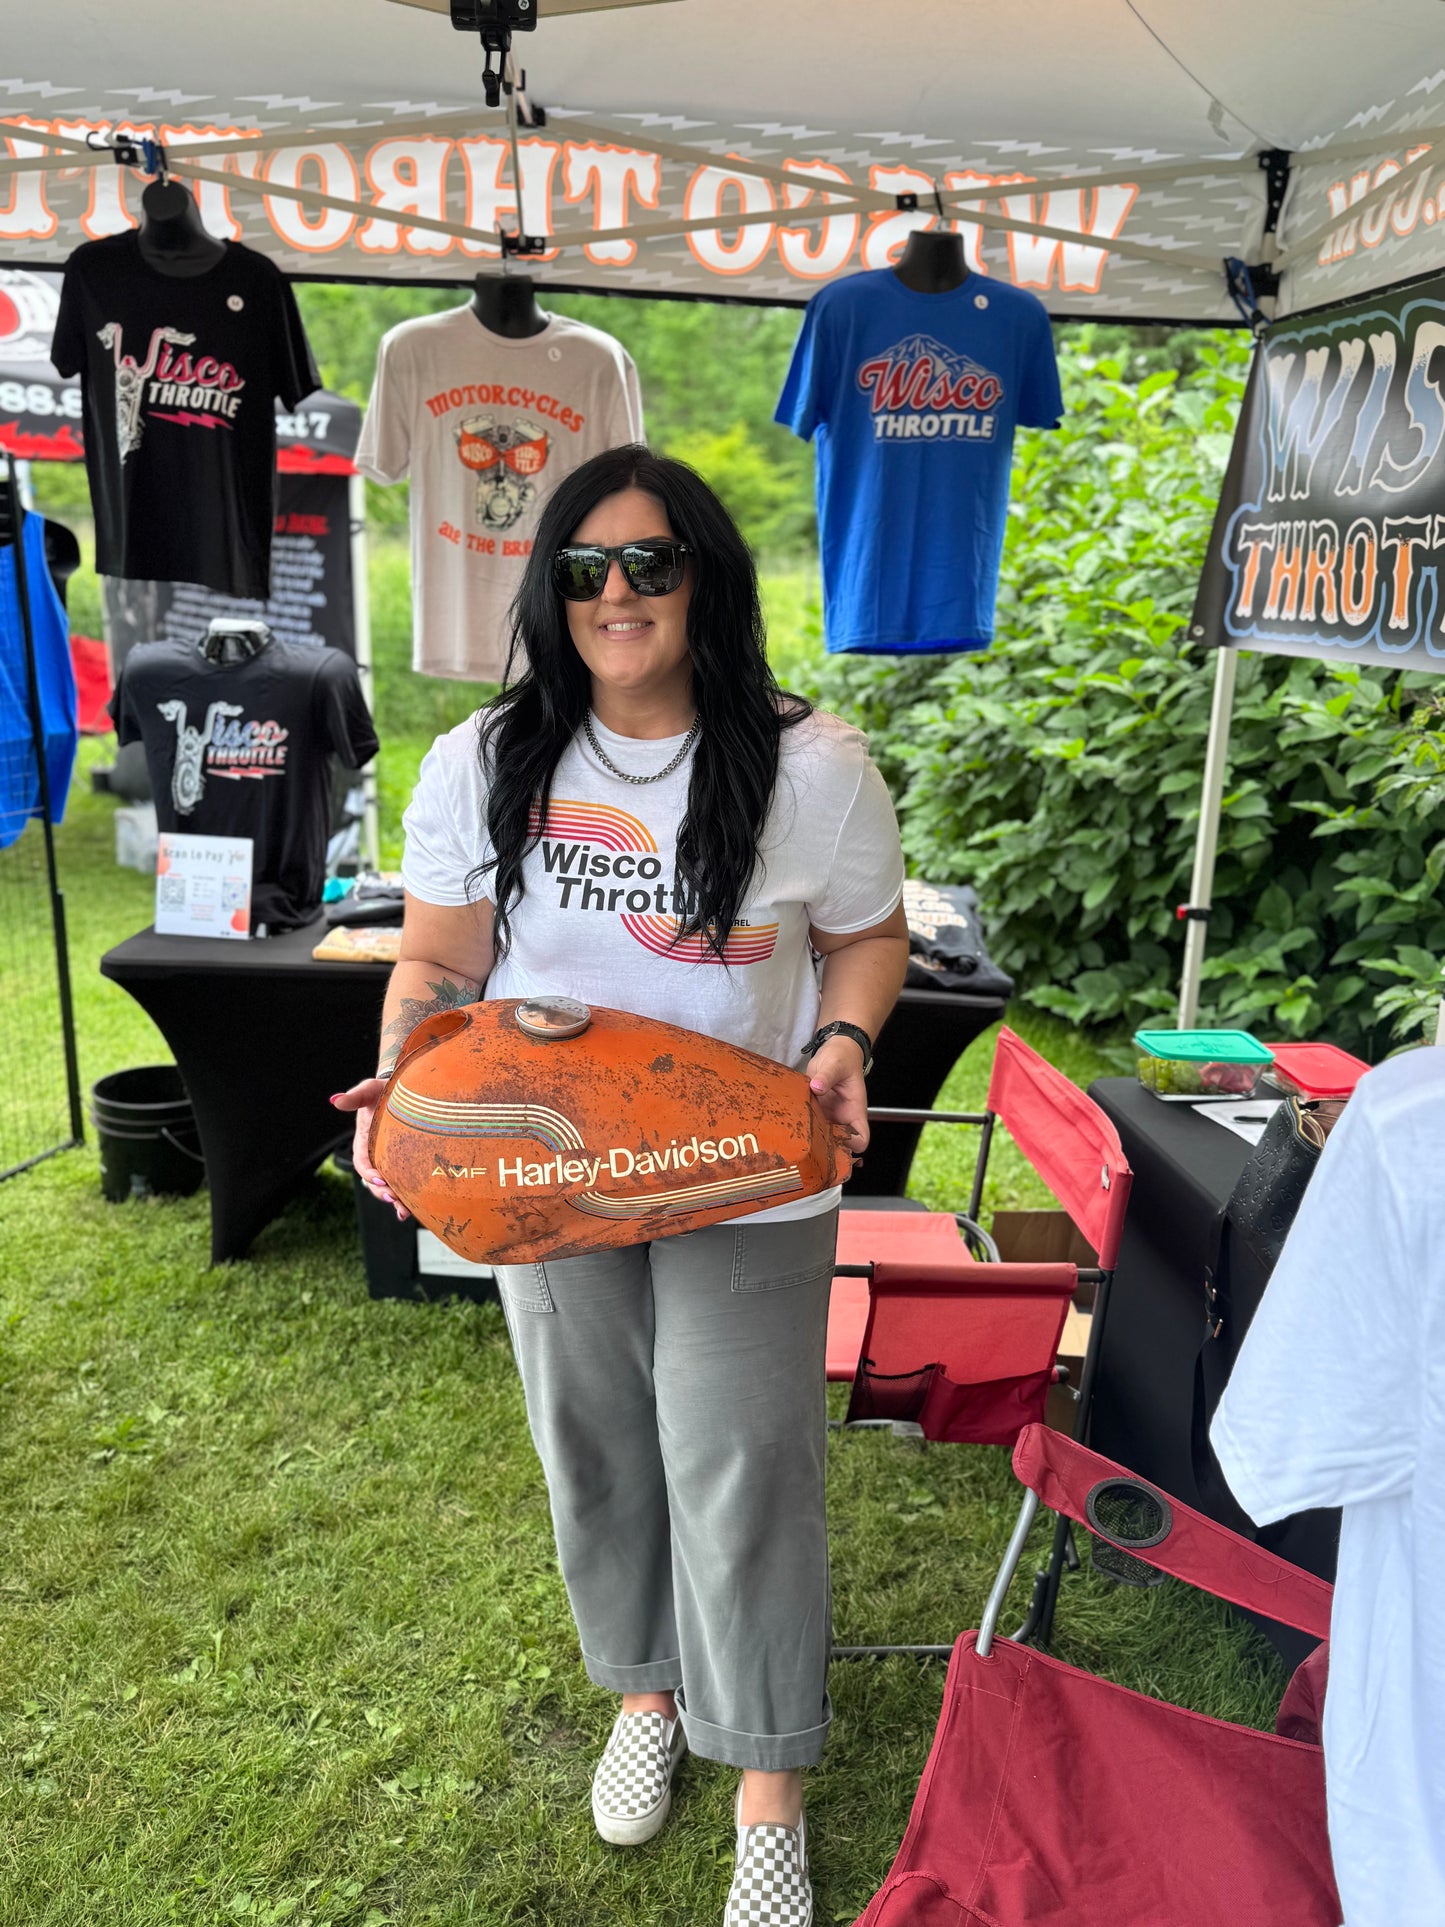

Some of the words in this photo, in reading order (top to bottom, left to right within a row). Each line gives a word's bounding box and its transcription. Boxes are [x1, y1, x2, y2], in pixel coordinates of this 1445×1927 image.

[149, 381, 242, 418] THROTTLE
[859, 355, 1003, 413] Wisco
[874, 413, 994, 438] THROTTLE
[1235, 514, 1445, 632] THROT
[206, 746, 288, 765] THROTTLE
[163, 847, 188, 859] Scan
[542, 841, 661, 879] Wisco
[555, 876, 698, 915] Throttl
[431, 1166, 487, 1178] AMF
[498, 1131, 759, 1188] Harley-Davidson
